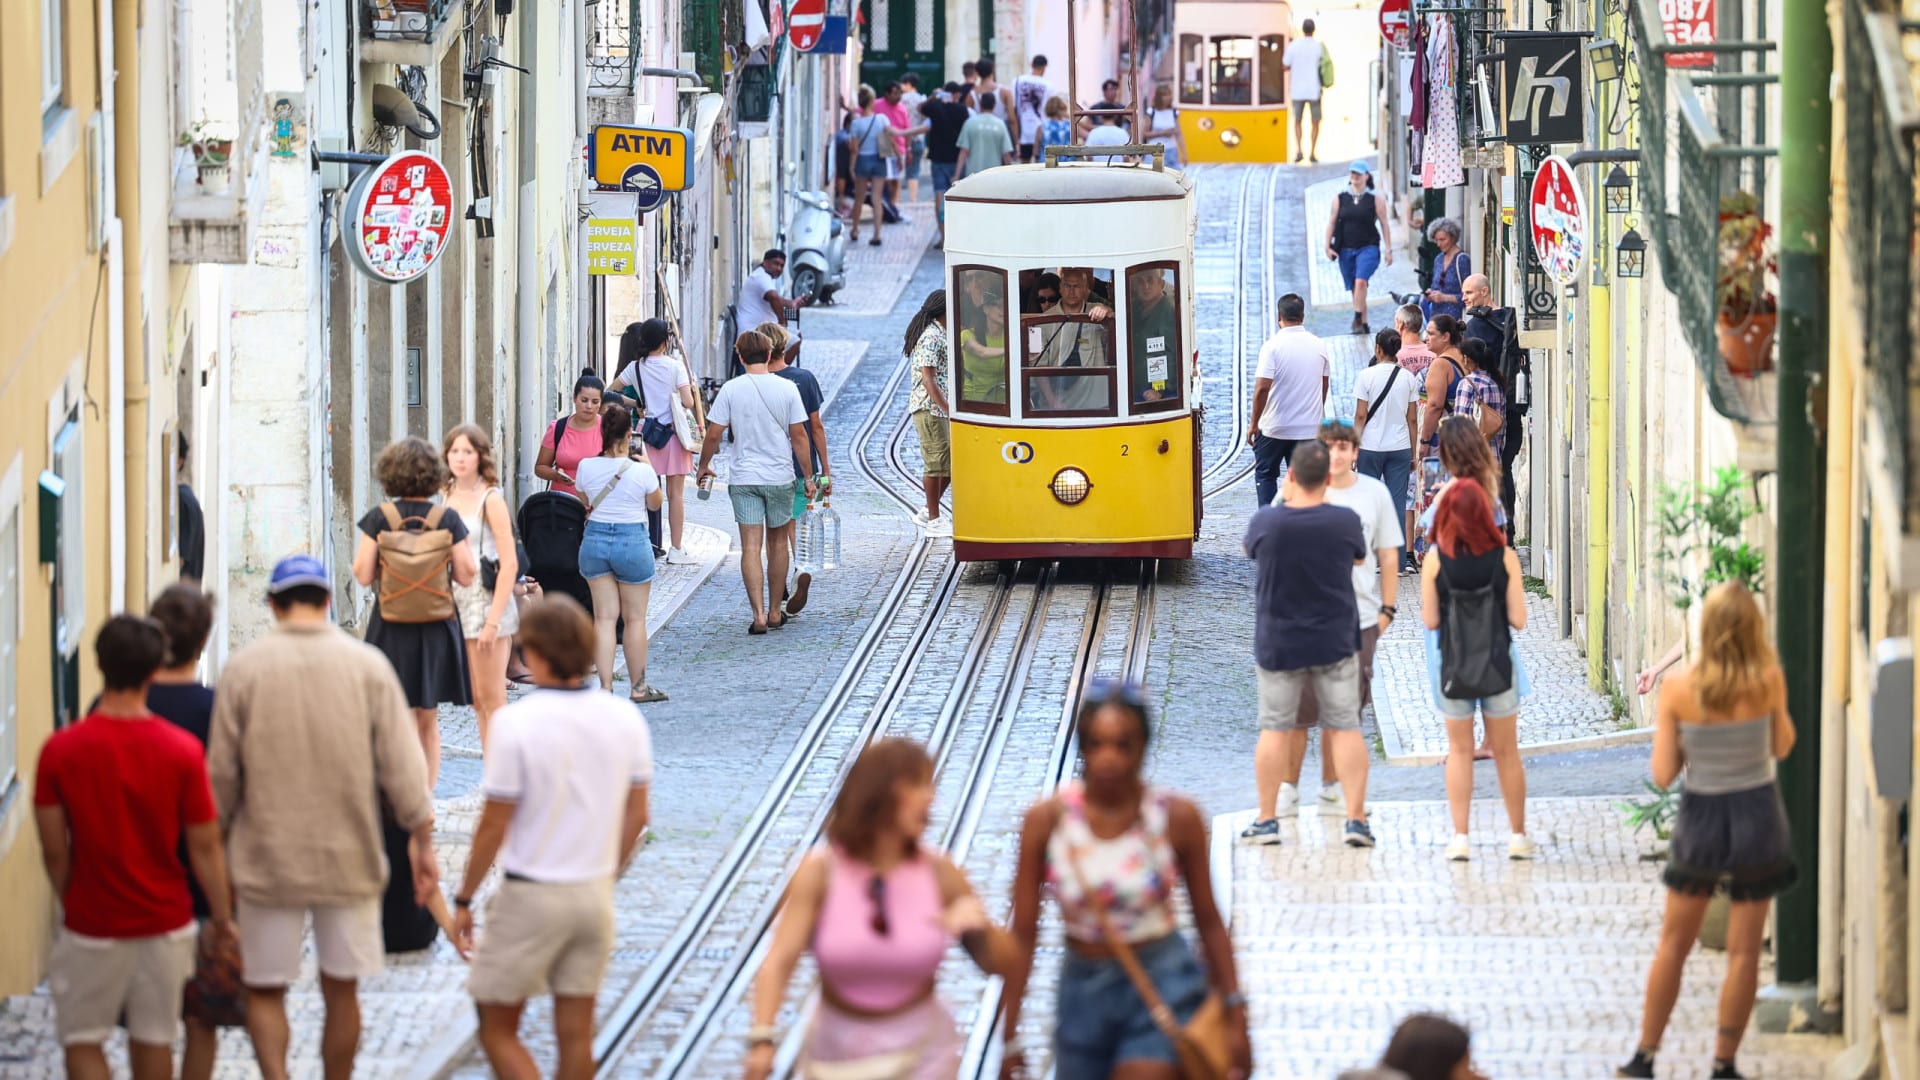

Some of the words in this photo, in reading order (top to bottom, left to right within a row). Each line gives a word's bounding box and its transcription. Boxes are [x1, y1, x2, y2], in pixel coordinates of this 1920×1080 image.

[611, 133, 672, 157] ATM
[588, 226, 631, 237] ERVEJA
[587, 242, 632, 252] ERVEZA
[588, 256, 628, 268] IÈRE
[1401, 356, 1418, 366] BORN
[1121, 444, 1129, 456] 2
